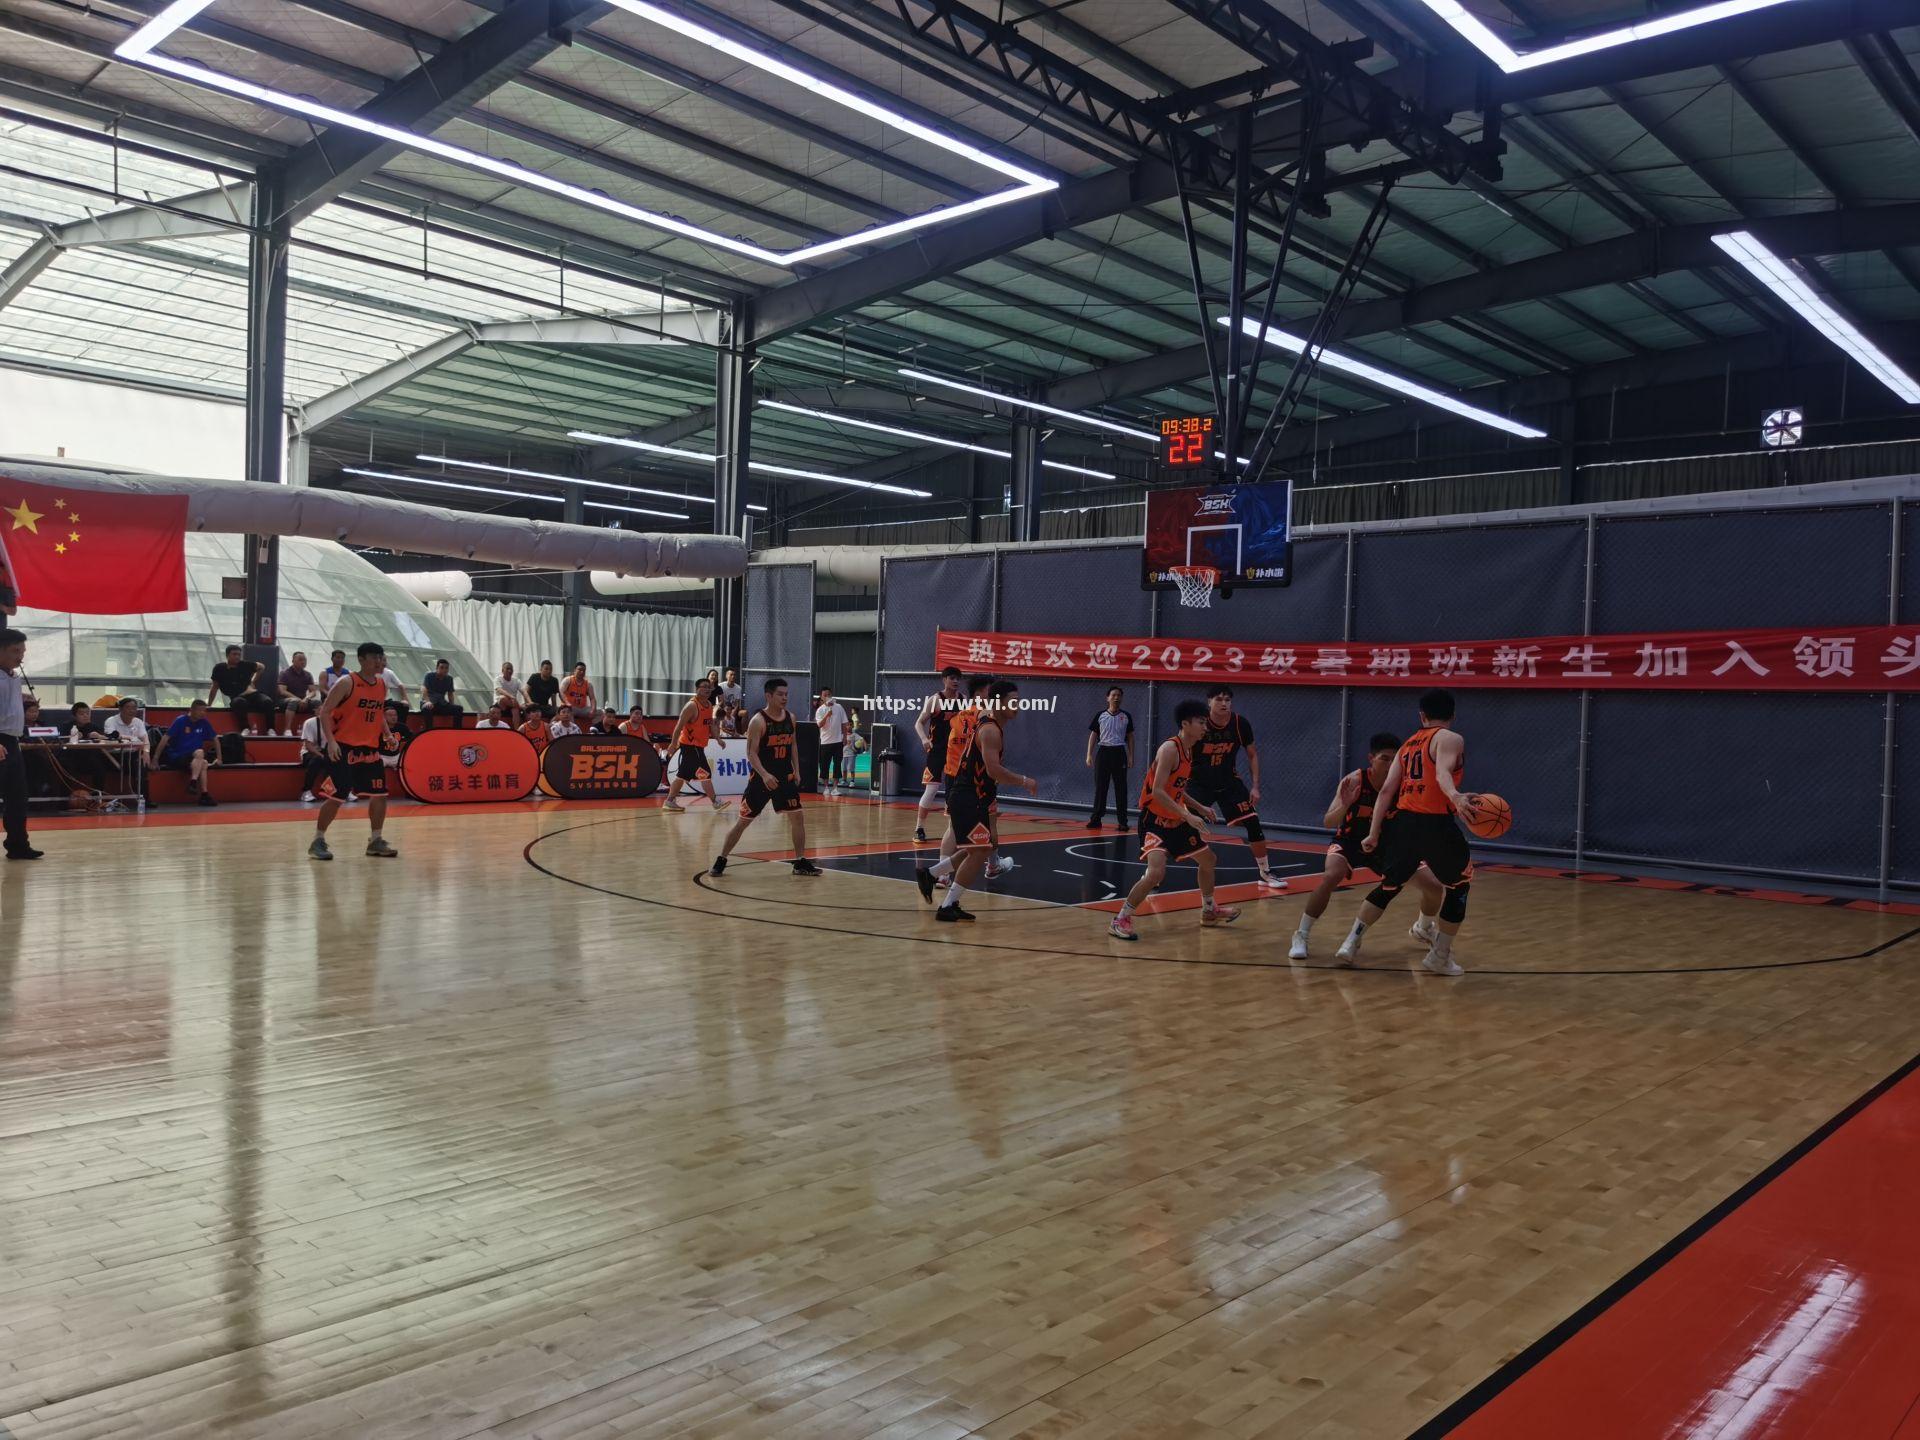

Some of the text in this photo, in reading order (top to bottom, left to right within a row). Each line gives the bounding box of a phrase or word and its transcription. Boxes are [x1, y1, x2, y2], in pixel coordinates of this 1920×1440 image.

[1162, 418, 1212, 435] 09:38.2
[1169, 434, 1203, 463] 22
[774, 747, 787, 759] 10
[569, 754, 640, 780] BSK
[1402, 749, 1424, 780] 10
[428, 774, 520, 792] 领头羊体育
